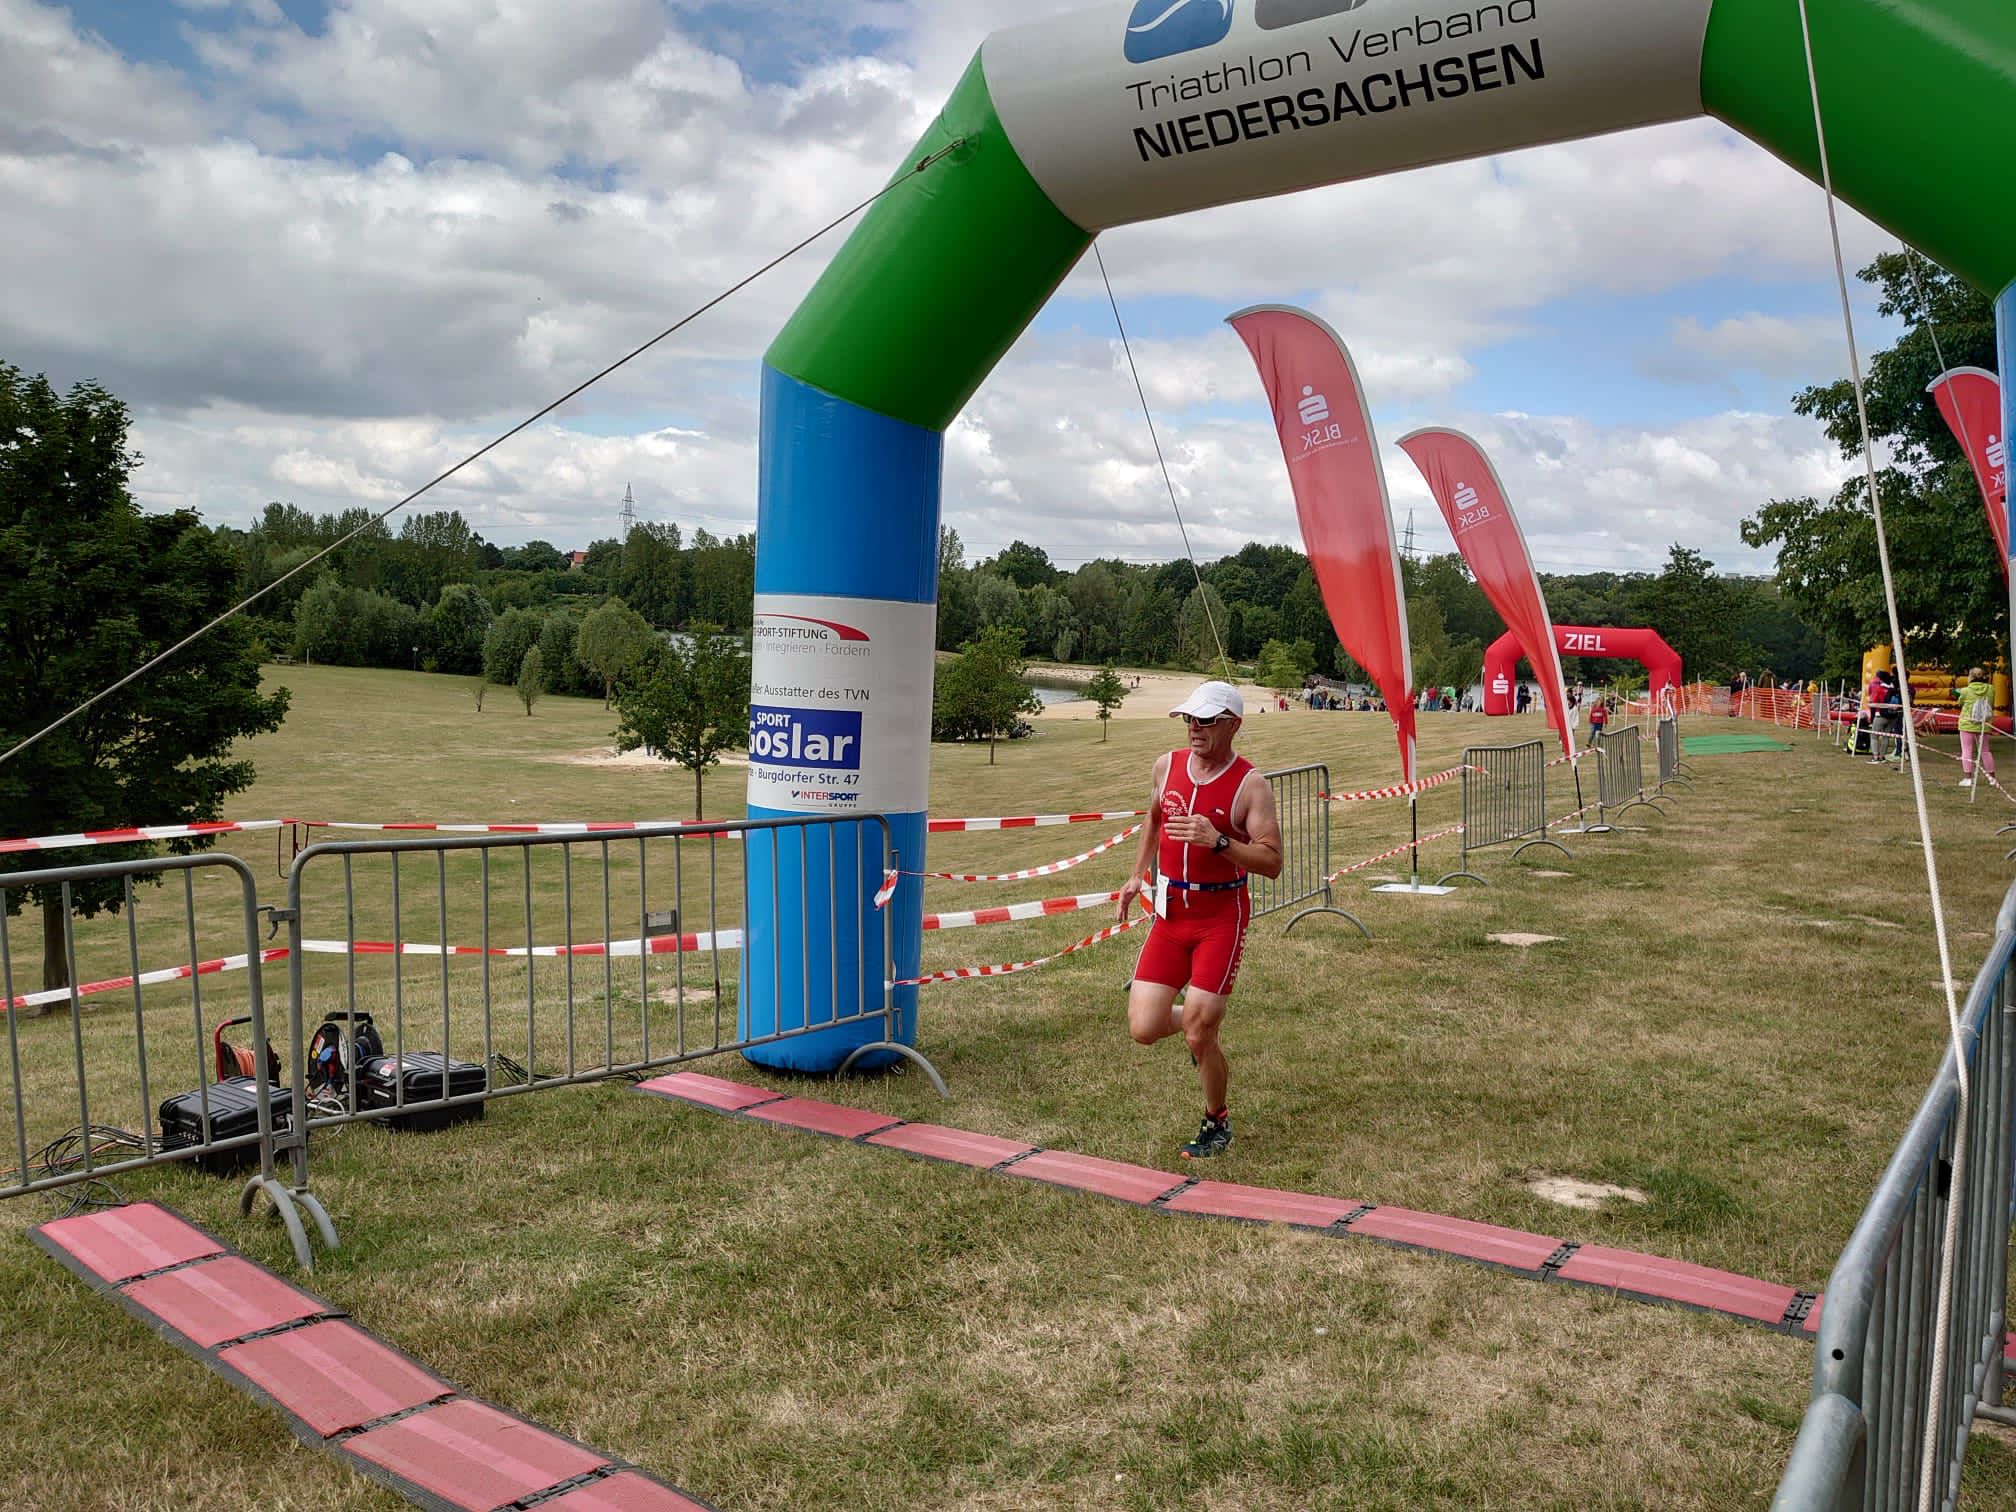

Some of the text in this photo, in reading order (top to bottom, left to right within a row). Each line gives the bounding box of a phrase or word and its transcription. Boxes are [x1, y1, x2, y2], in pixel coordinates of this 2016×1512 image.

[1125, 0, 1536, 110] Triathlon Verband
[1133, 38, 1545, 162] NIEDERSACHSEN
[1564, 634, 1606, 651] ZIEL
[764, 684, 815, 697] Ausstatter
[818, 687, 840, 699] des
[844, 688, 870, 700] TVN
[757, 711, 791, 728] SPORT
[758, 768, 814, 783] Burgdorfer
[818, 772, 840, 785] Str.
[843, 774, 860, 785] 47
[801, 791, 859, 801] INTERSPORT
